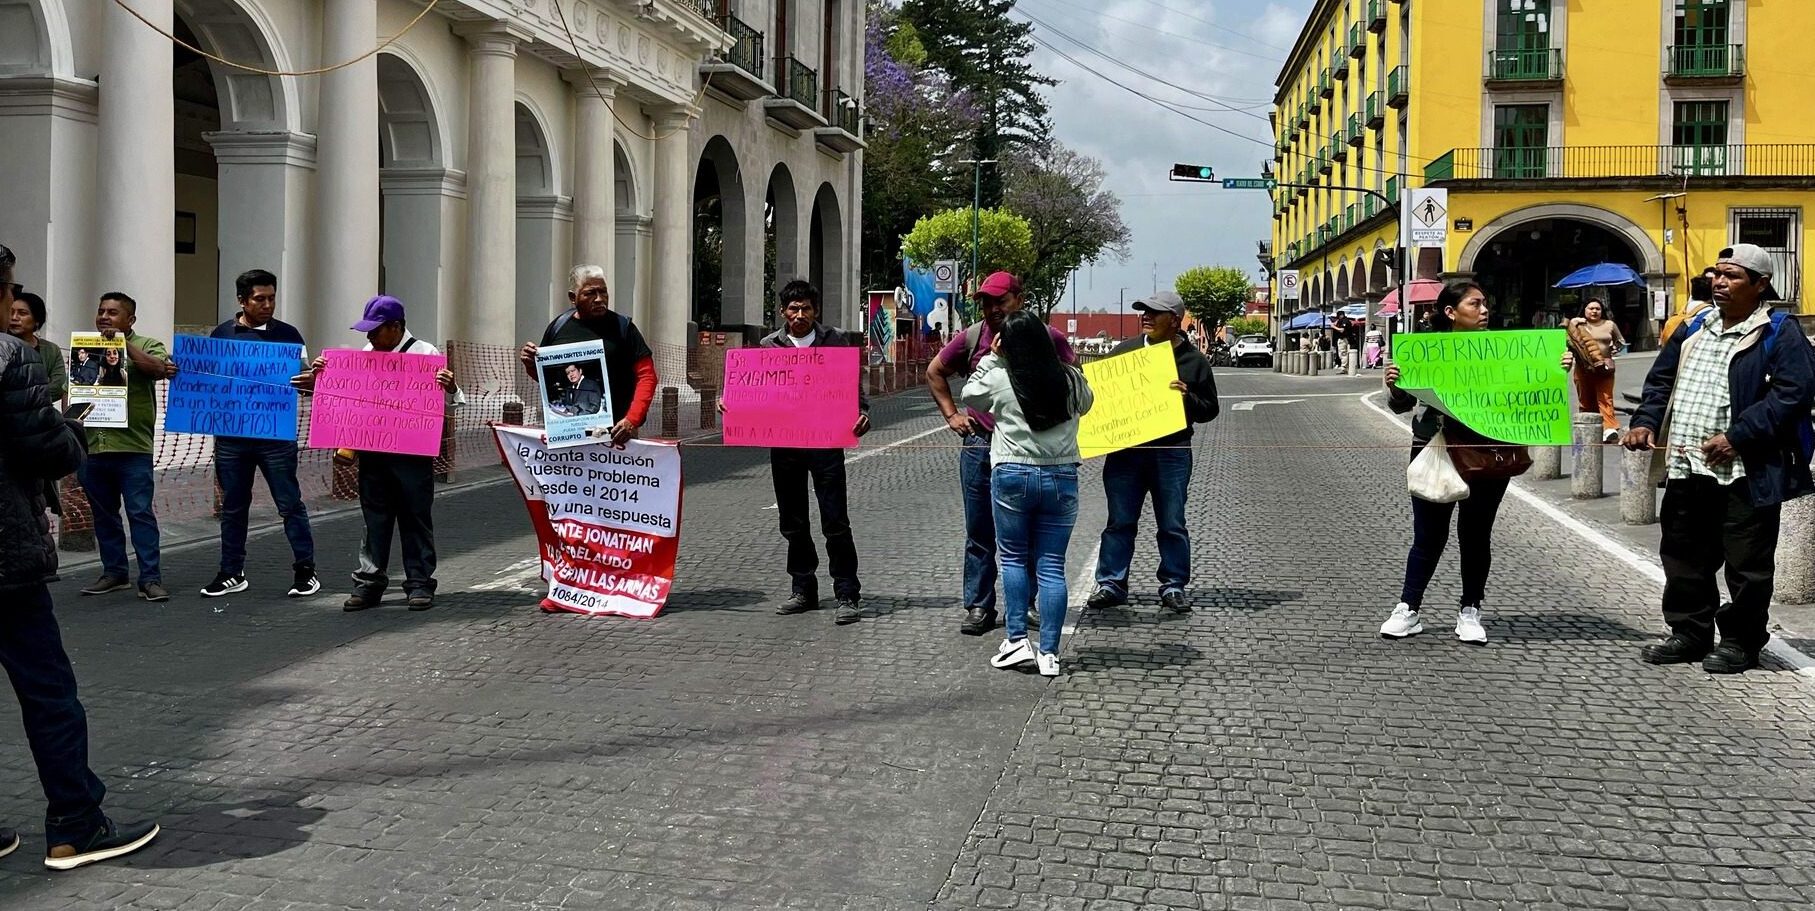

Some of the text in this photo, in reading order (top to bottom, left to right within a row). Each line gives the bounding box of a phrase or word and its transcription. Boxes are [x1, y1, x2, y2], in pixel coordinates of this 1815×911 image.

[175, 336, 241, 357] JONATHAN
[760, 348, 825, 366] Presidente
[1395, 335, 1548, 363] GOBERNADORA
[175, 357, 221, 376] ROSARIO
[1092, 349, 1152, 383] POPULAR
[1454, 364, 1518, 387] NAHLE
[318, 371, 361, 391] Rosario
[1130, 371, 1152, 392] LA
[548, 434, 582, 443] CORRUPTO
[516, 443, 530, 457] la
[589, 450, 654, 469] solución
[588, 468, 660, 488] problema
[582, 484, 596, 498] el
[599, 487, 639, 504] 2014
[564, 502, 593, 516] una
[598, 506, 671, 529] respuesta
[584, 528, 654, 555] JONATHAN
[589, 570, 616, 592] LAS
[552, 586, 608, 609] 1084/2014
